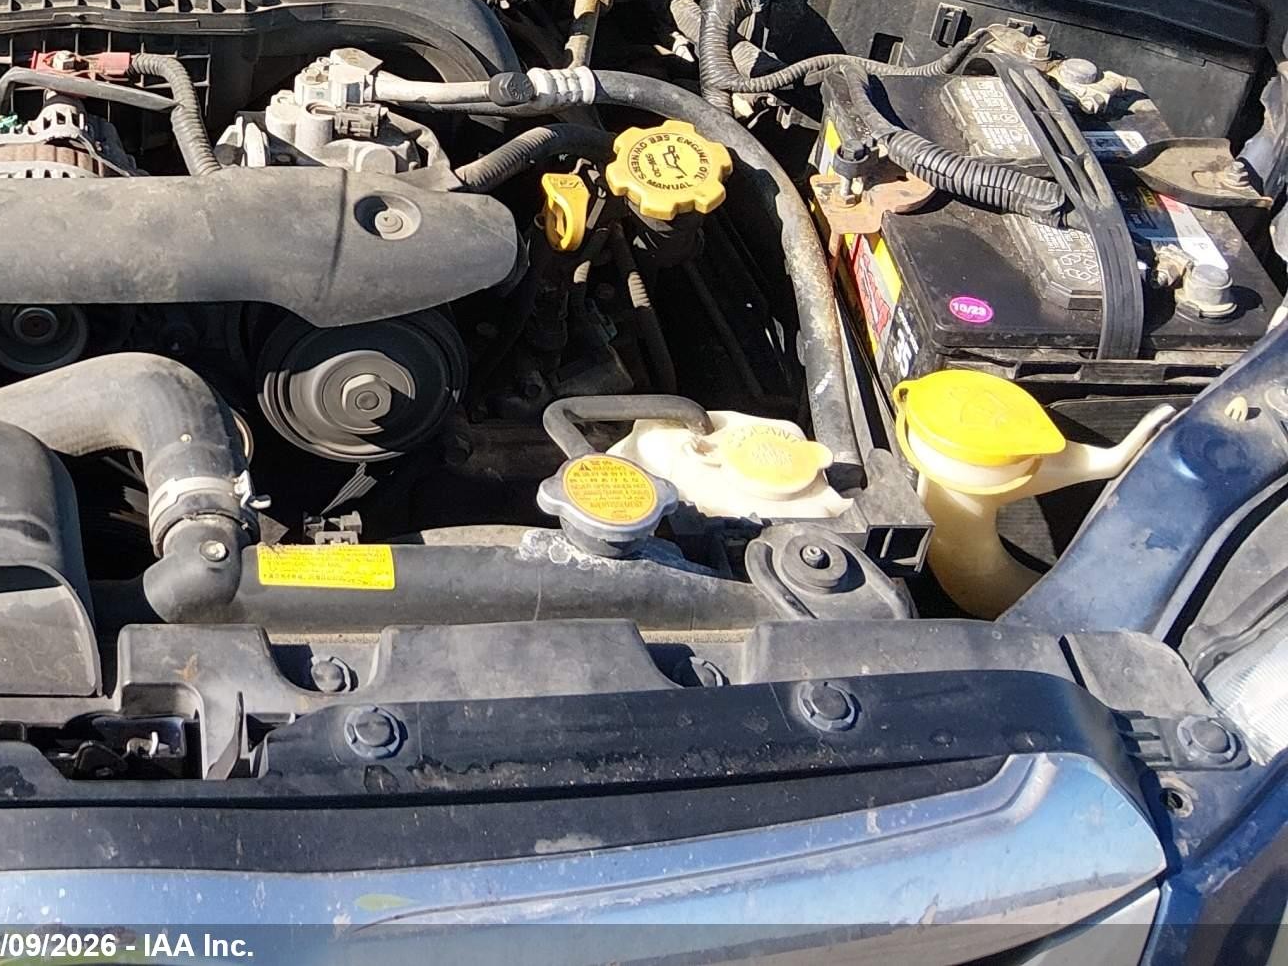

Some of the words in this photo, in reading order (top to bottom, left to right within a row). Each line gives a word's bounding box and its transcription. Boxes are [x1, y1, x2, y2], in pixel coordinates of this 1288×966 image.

[649, 134, 670, 145] SEE
[676, 136, 710, 165] ENGINE
[693, 166, 708, 181] OIL
[646, 178, 693, 191] MANUAL
